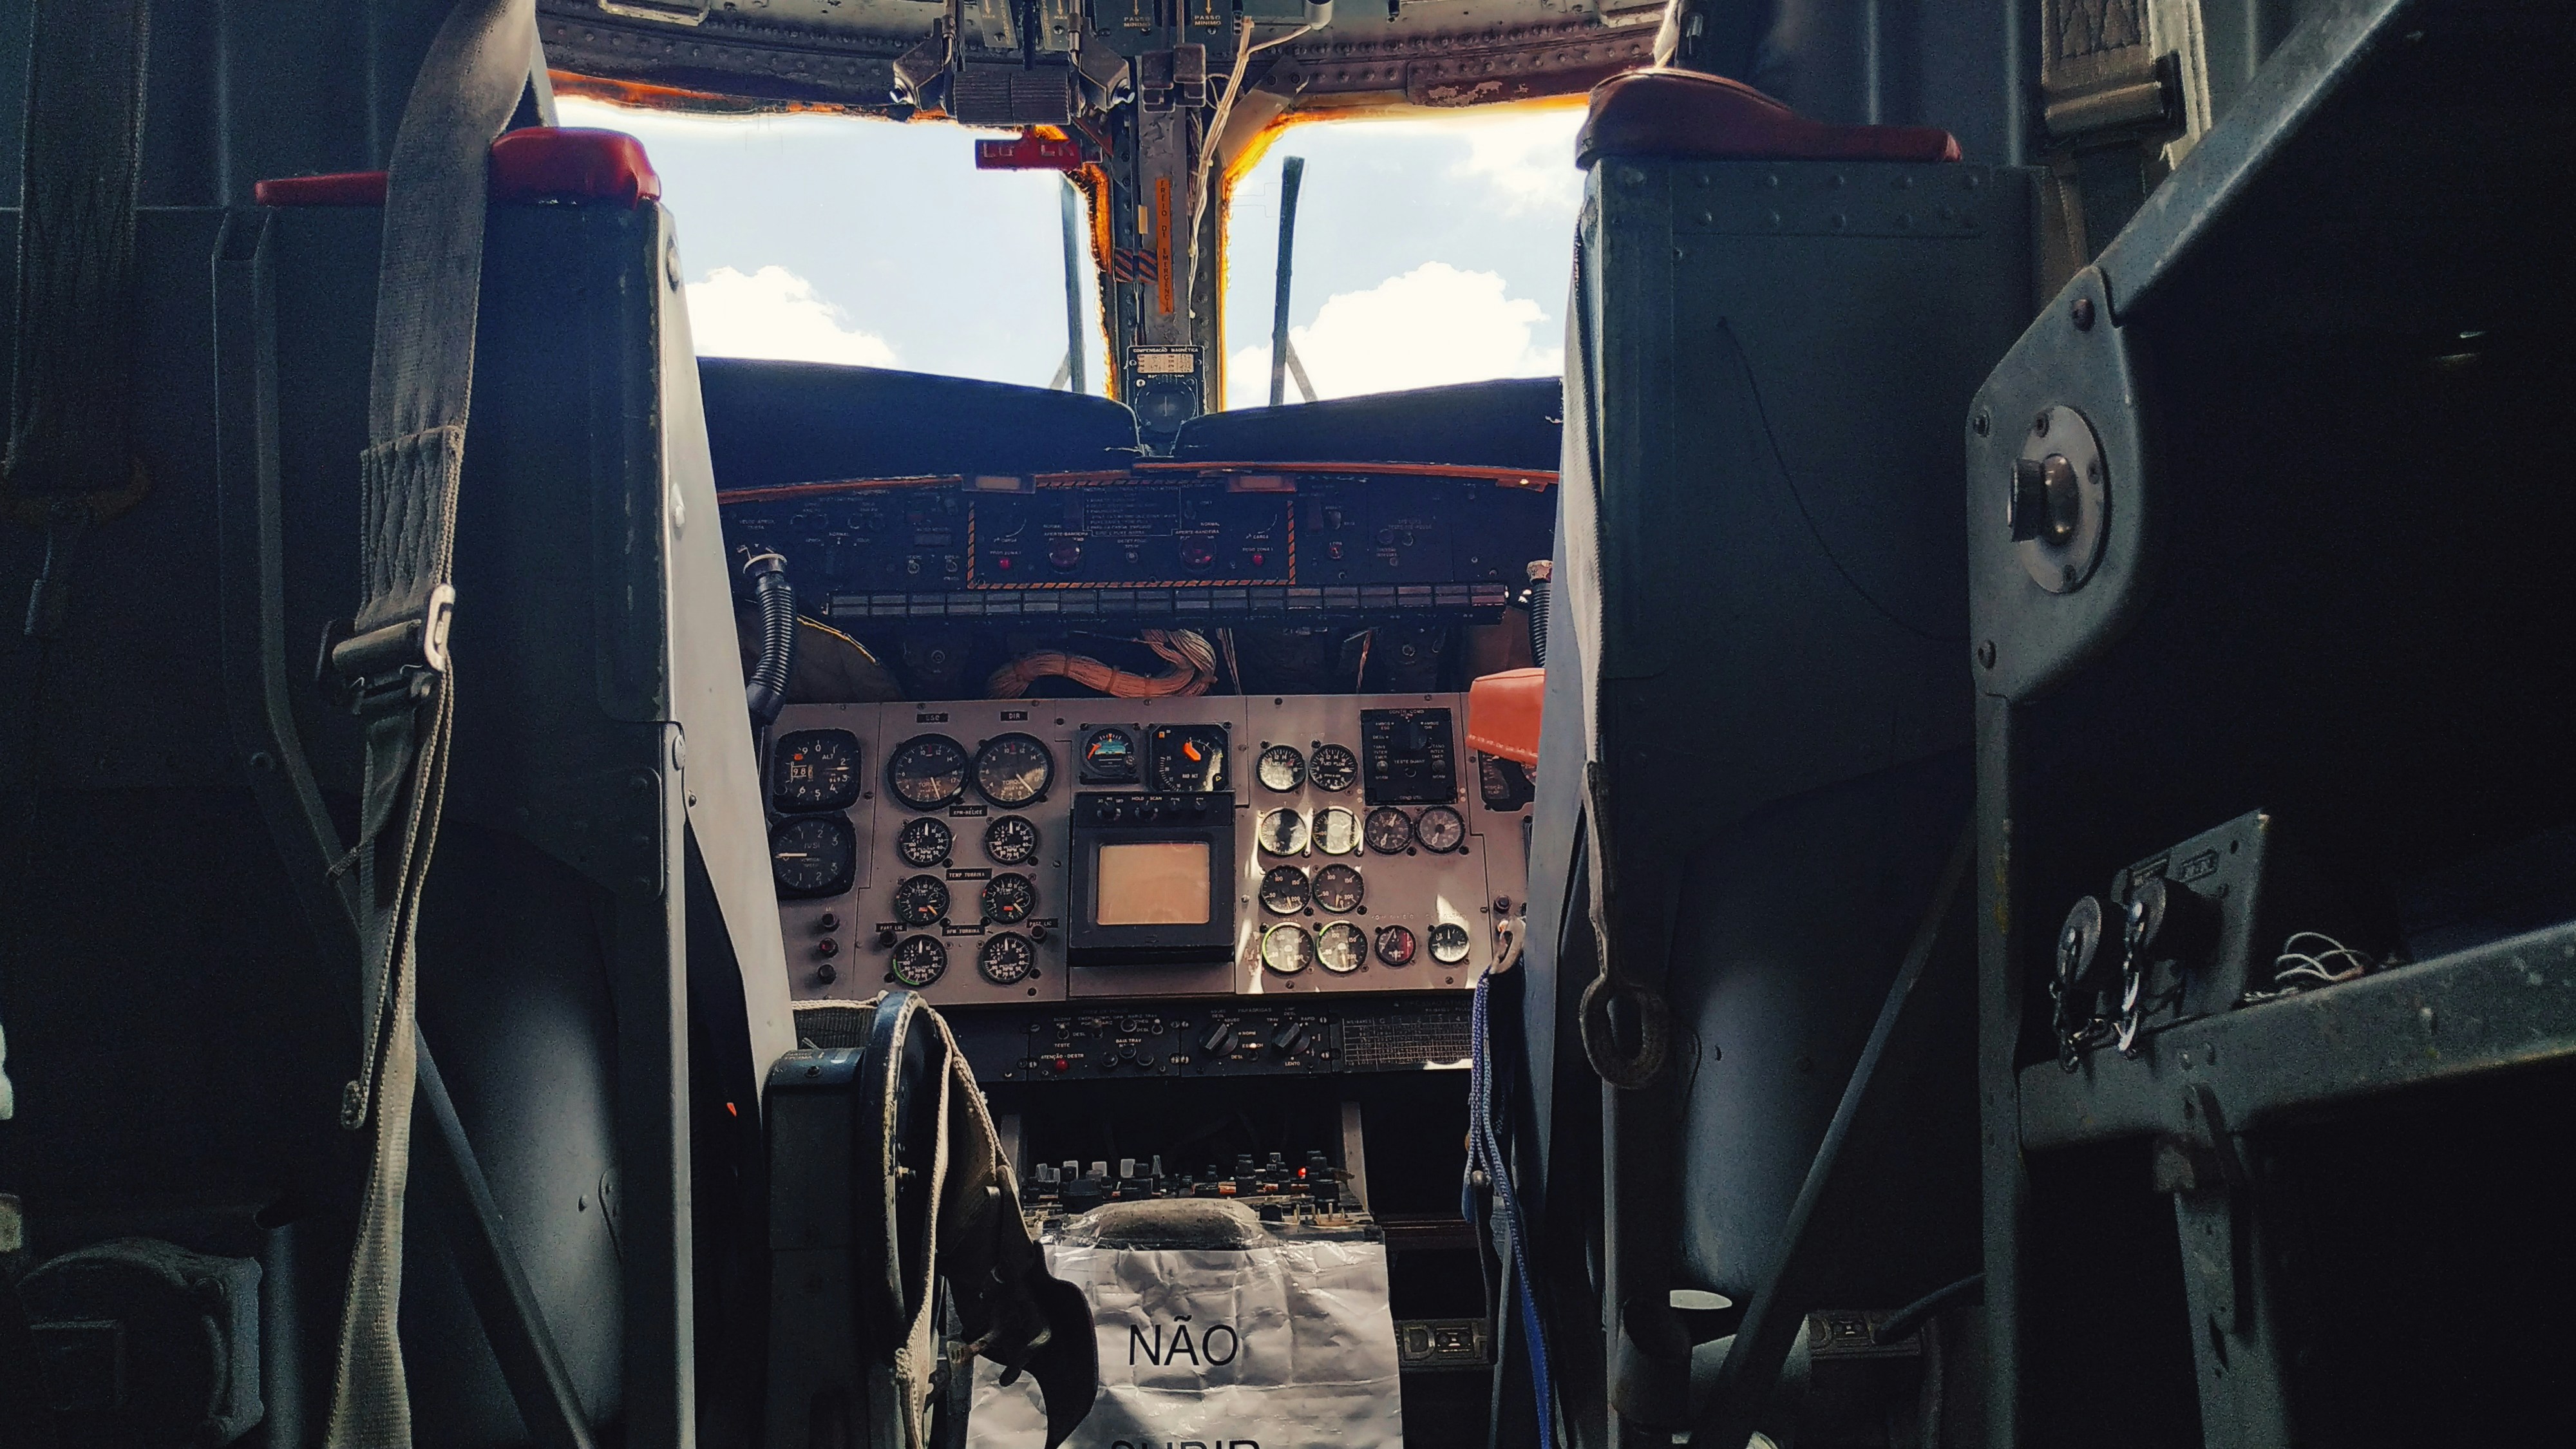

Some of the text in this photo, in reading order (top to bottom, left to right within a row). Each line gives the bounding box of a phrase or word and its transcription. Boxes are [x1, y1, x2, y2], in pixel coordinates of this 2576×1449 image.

[1162, 226, 1168, 238] DE
[840, 757, 846, 766] 2
[817, 829, 824, 838] 2
[831, 837, 838, 846] 3
[831, 863, 837, 872] 3
[816, 872, 822, 880] 2
[1129, 1315, 1238, 1366] NÃO
